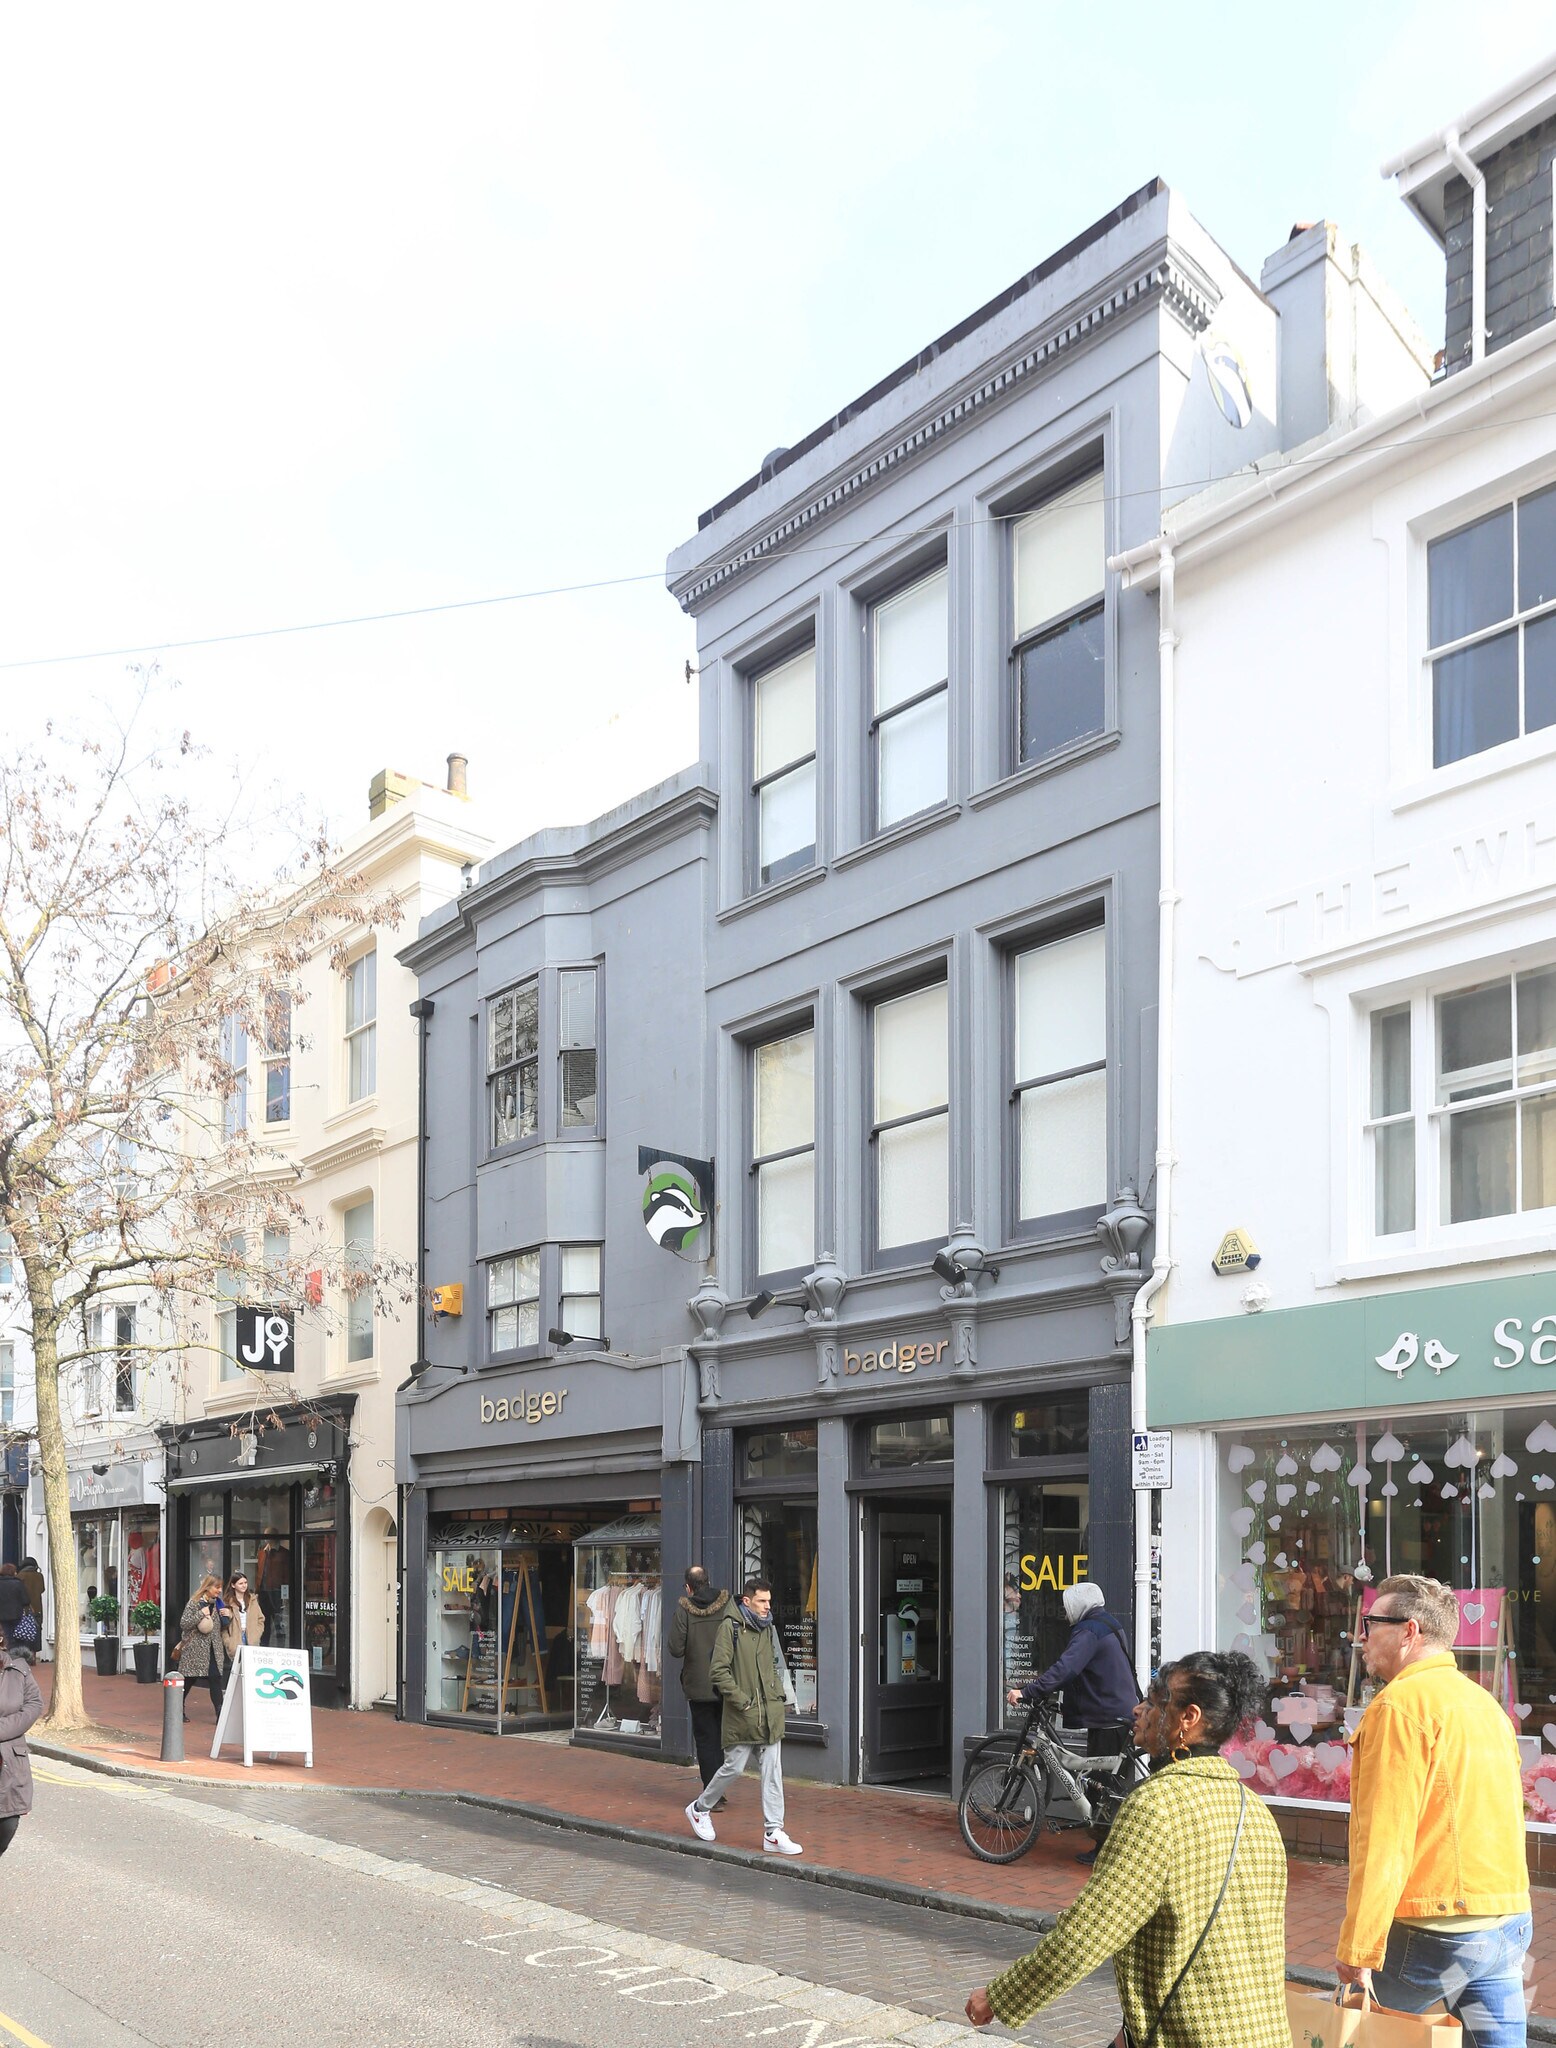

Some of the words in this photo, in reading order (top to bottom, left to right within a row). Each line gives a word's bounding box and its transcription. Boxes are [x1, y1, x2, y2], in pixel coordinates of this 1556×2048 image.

[1265, 862, 1411, 953] THE
[1221, 1253, 1243, 1261] SUSSEX
[242, 1315, 289, 1365] JOY
[844, 1340, 949, 1375] badger
[480, 1388, 568, 1425] badger
[902, 1553, 918, 1565] OPEN
[1020, 1554, 1089, 1591] SALE
[442, 1567, 474, 1593] SALE
[305, 1601, 319, 1610] NEW
[253, 1657, 274, 1665] 1988
[281, 1659, 302, 1667] 2018
